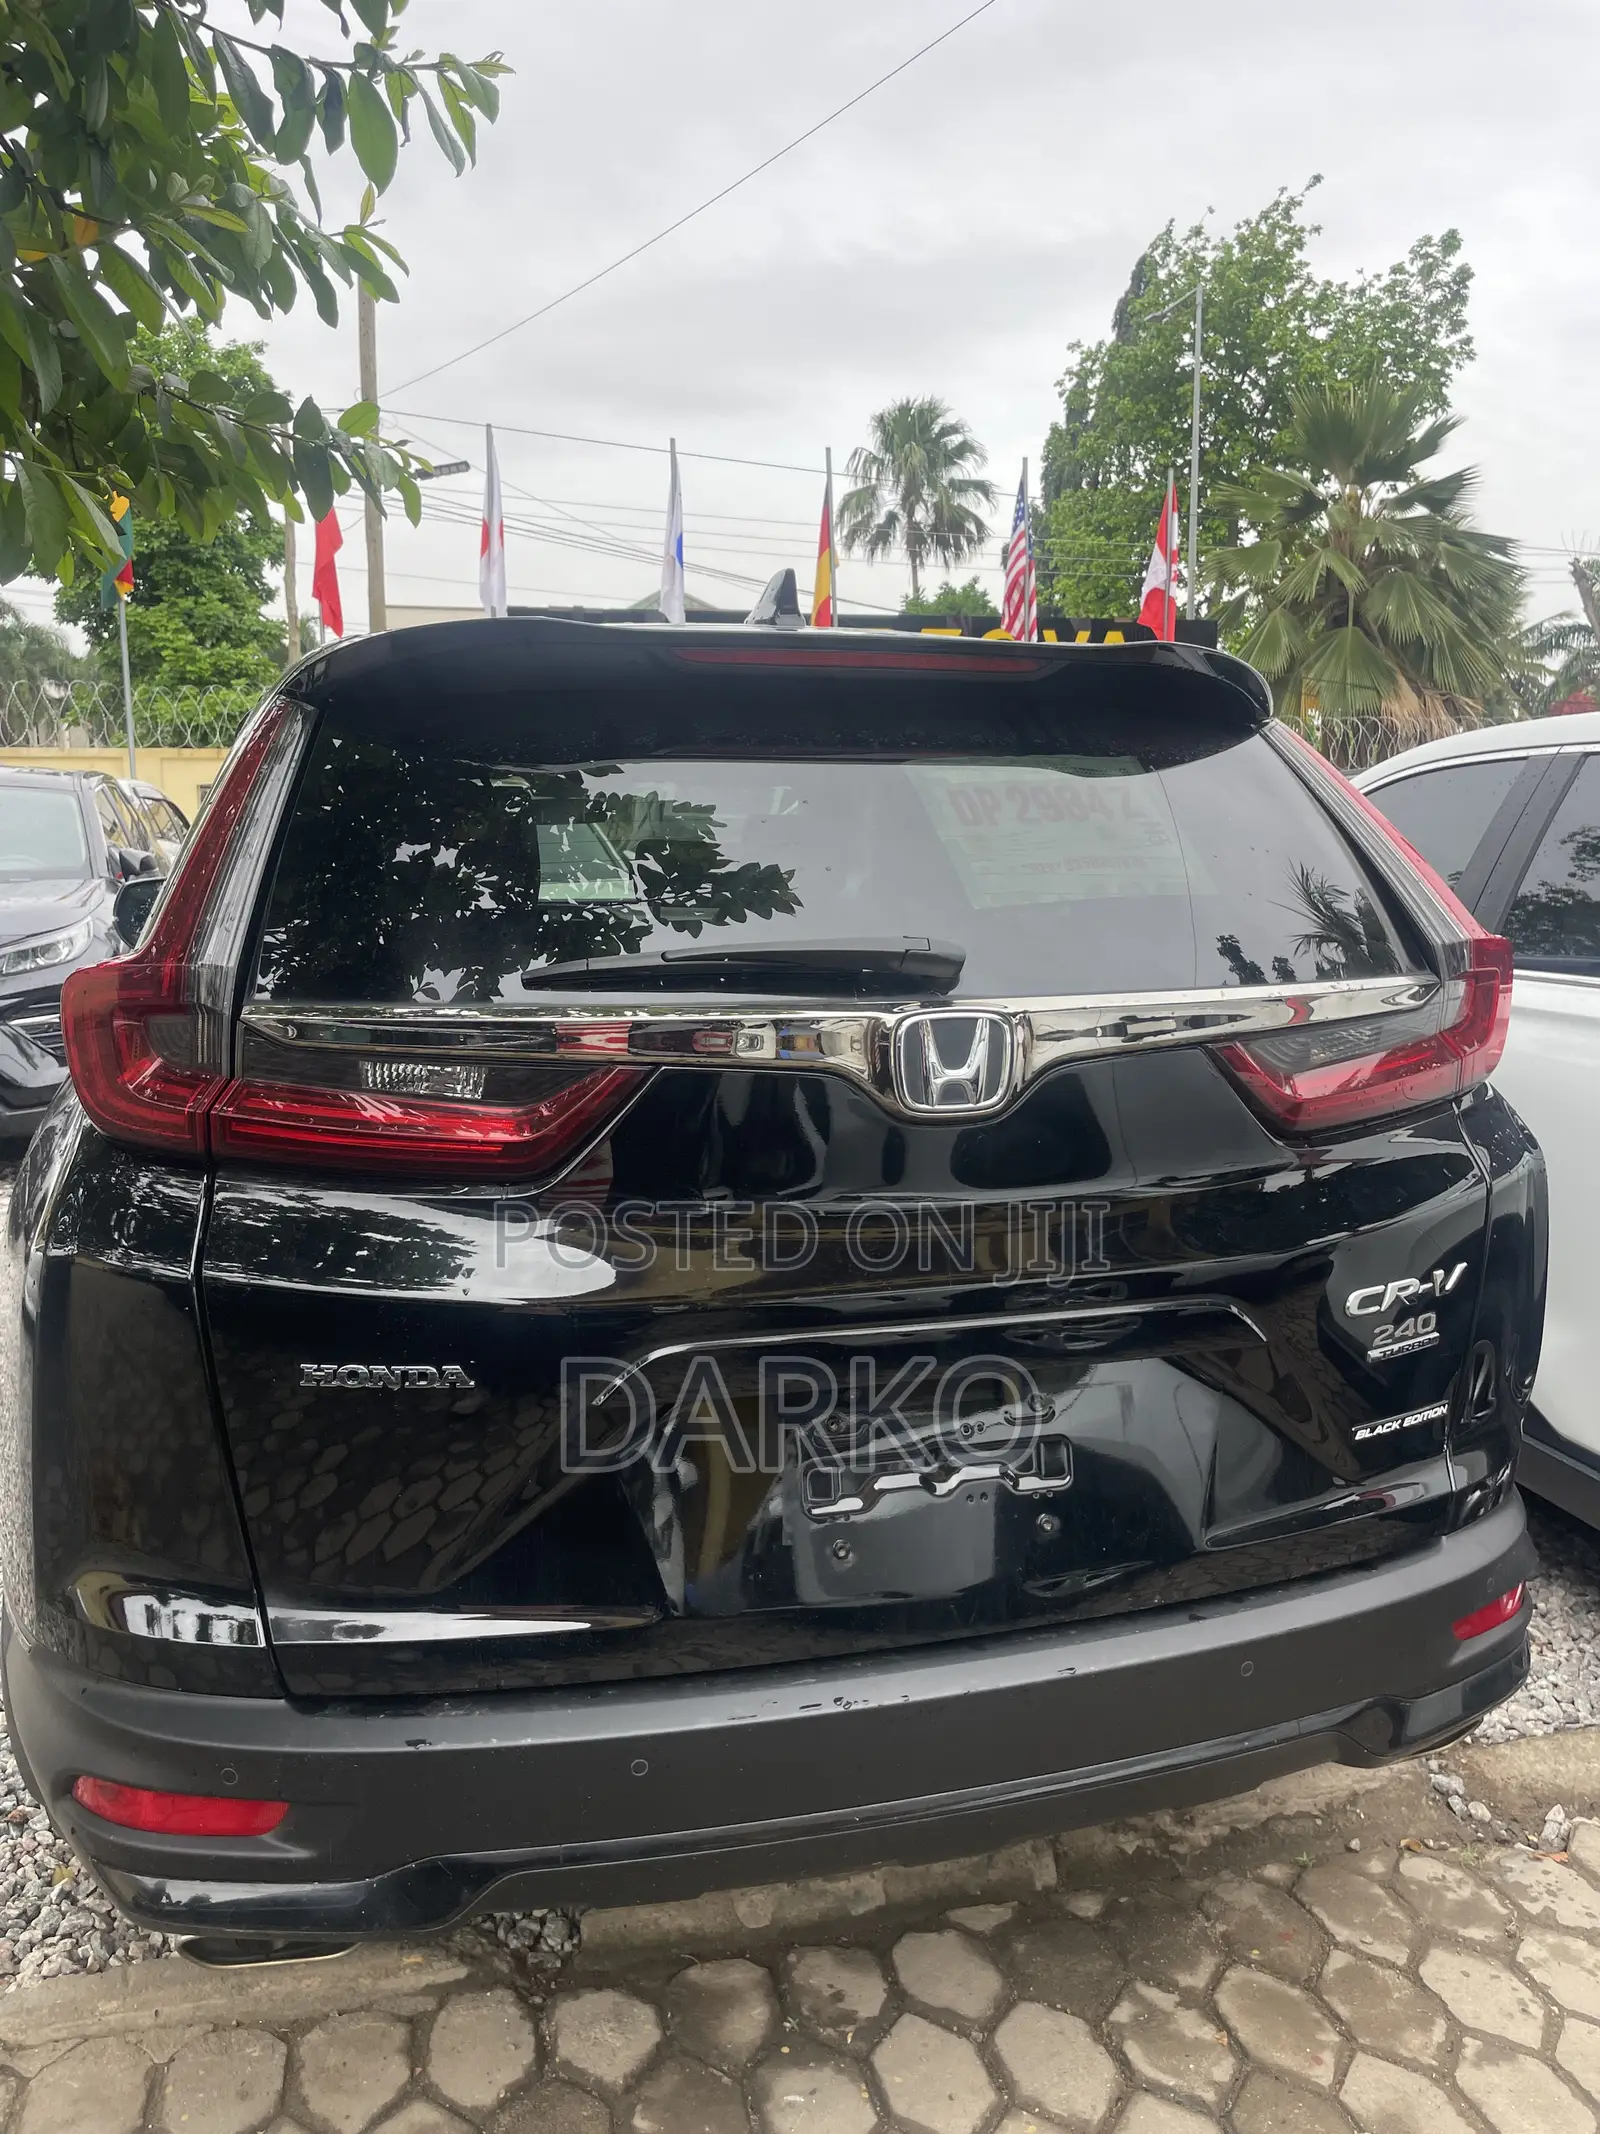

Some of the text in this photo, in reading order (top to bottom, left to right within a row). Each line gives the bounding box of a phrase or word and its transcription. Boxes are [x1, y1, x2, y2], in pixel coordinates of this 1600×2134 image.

[1345, 1261, 1468, 1318] CR-V
[1372, 1311, 1437, 1348] 240
[1379, 1337, 1432, 1359] TURBO
[299, 1363, 476, 1391] HONDA
[1354, 1403, 1448, 1441] BLACK EDITION
